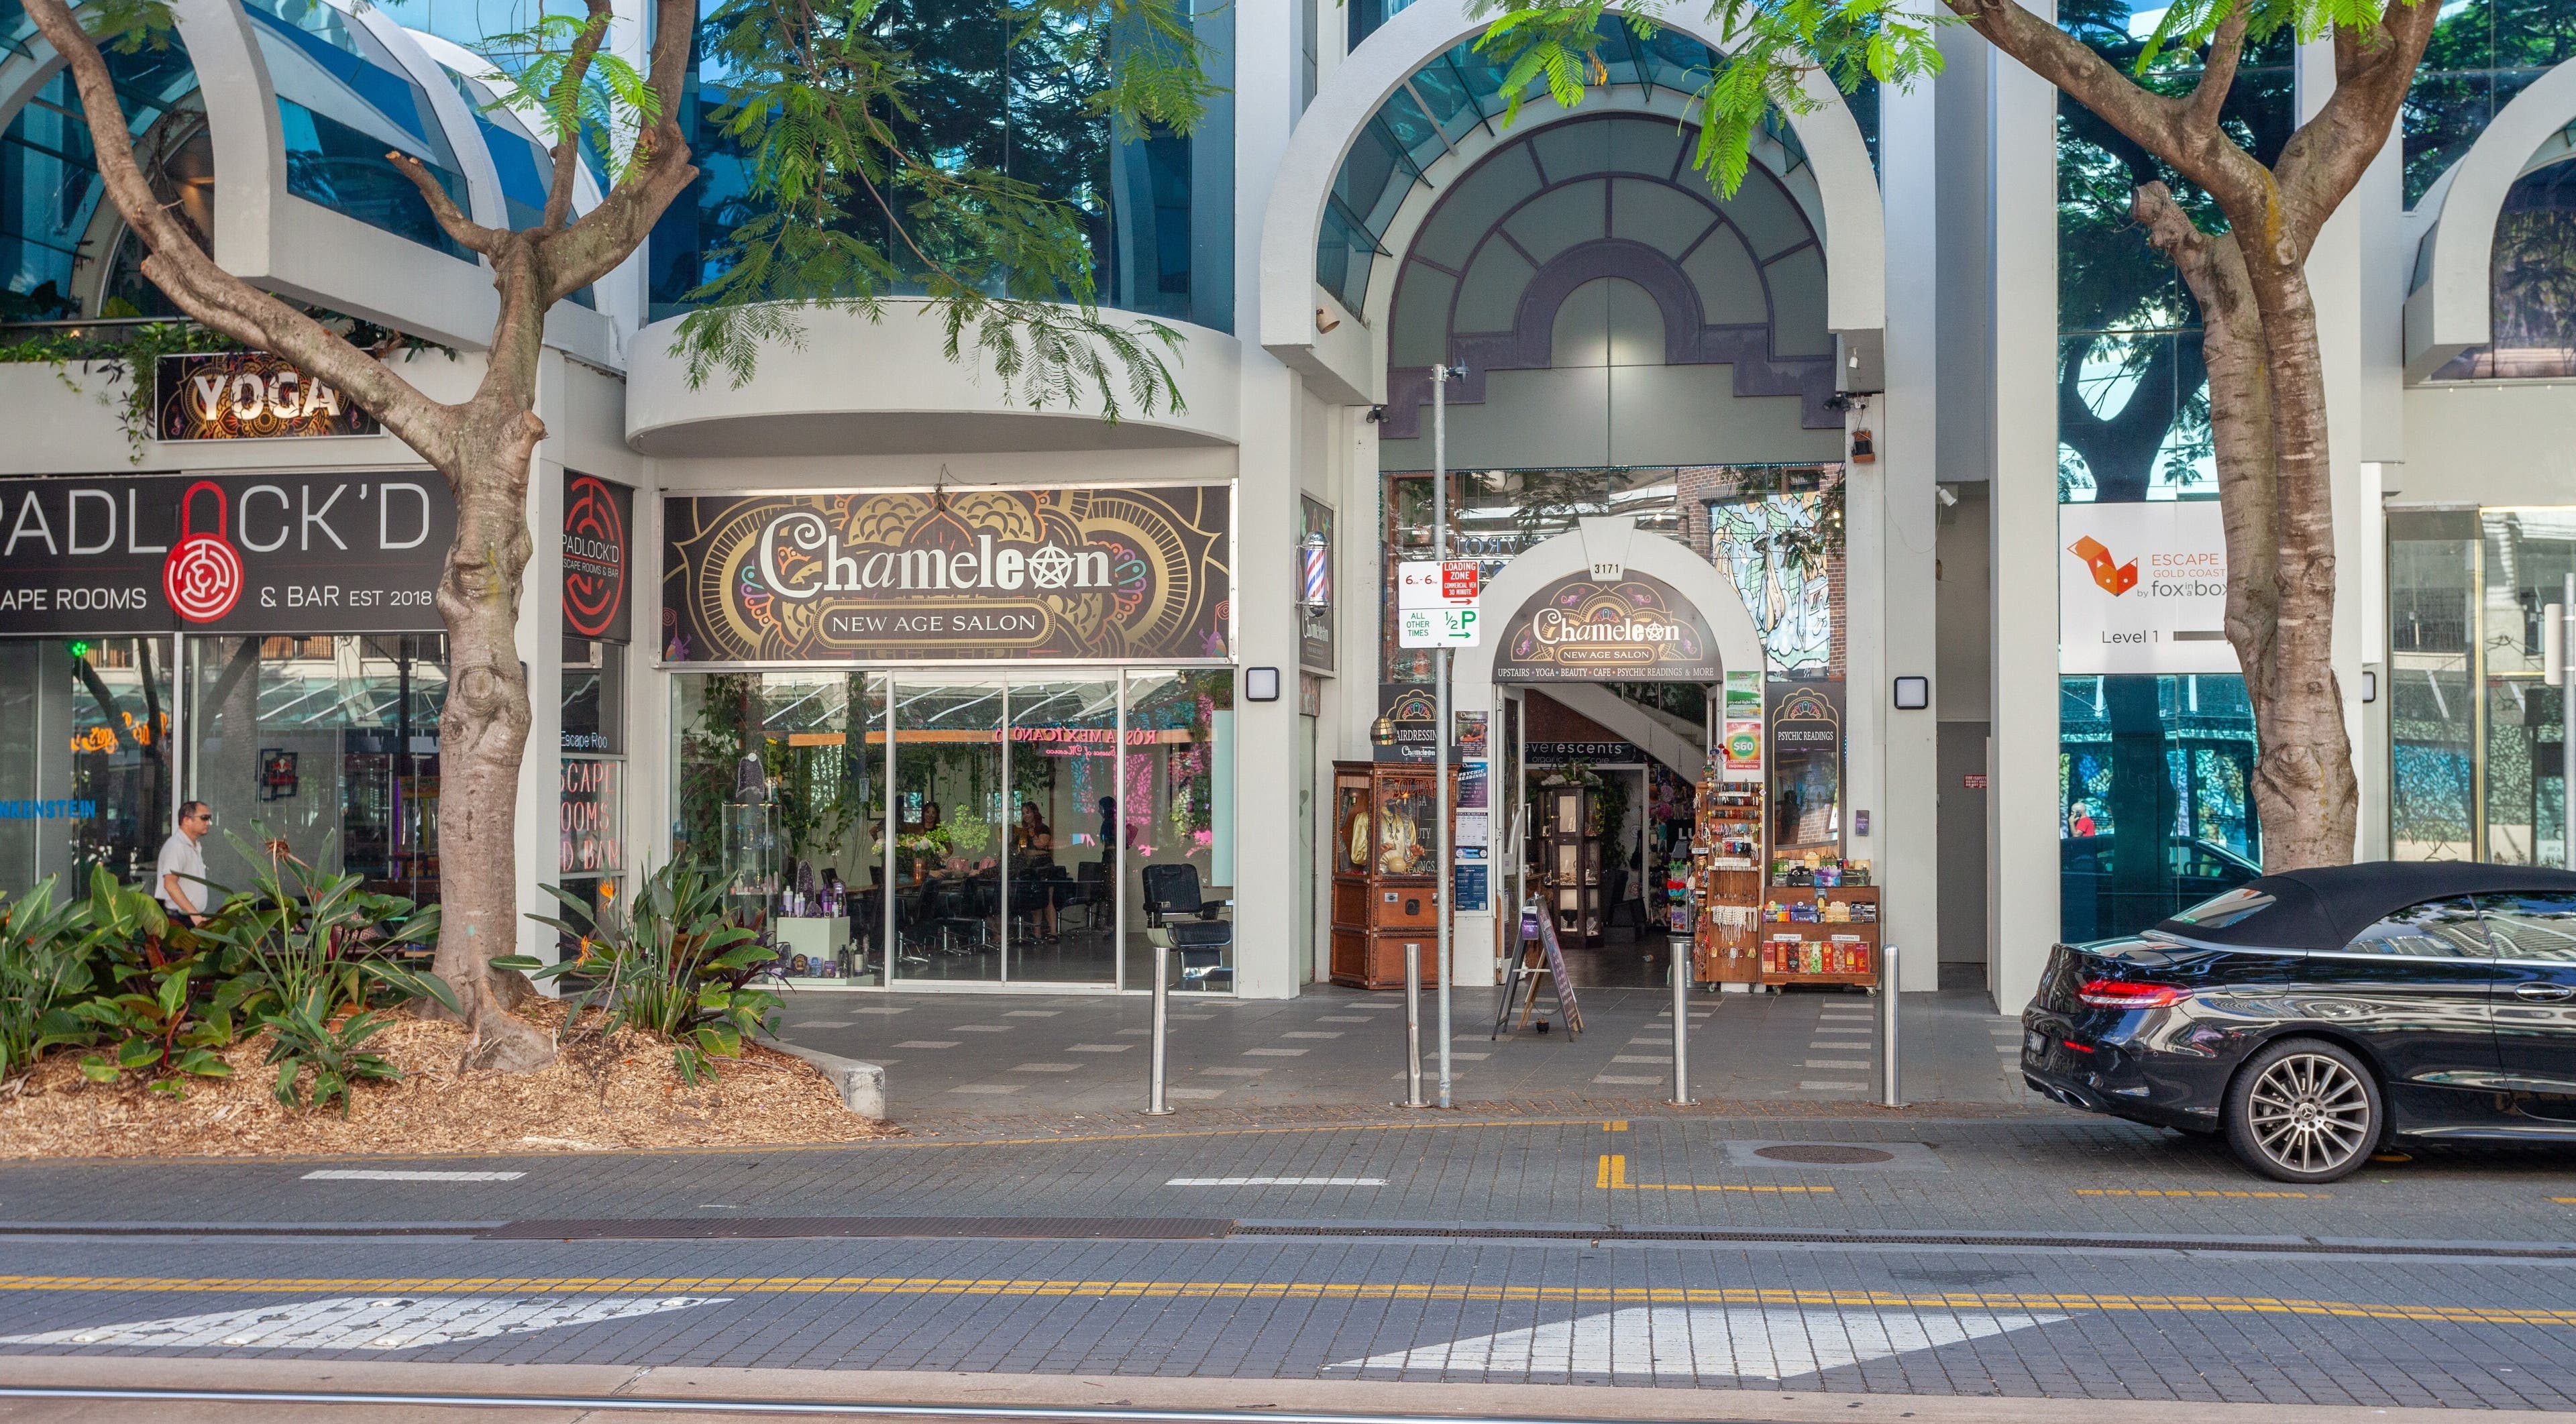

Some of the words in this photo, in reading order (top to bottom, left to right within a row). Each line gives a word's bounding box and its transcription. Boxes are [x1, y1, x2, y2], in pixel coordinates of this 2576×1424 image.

[194, 372, 340, 421] YOGA
[0, 481, 430, 557] ADLOCK'D
[760, 512, 1112, 598] Chameleon
[2151, 553, 2219, 566] ESCAPE
[564, 558, 581, 571] SCAPE
[582, 562, 602, 575] ROOMS
[608, 567, 619, 578] BAR
[1444, 562, 1476, 571] LOADING
[1594, 563, 1619, 574] 3171
[1450, 571, 1470, 580] ZONE
[2153, 569, 2185, 578] GOLD
[2188, 569, 2226, 578] COAST
[2137, 590, 2149, 598] by
[2151, 580, 2184, 597] fox
[0, 589, 48, 610] APE
[56, 588, 147, 610] ROOMS
[260, 586, 277, 608] &
[288, 585, 339, 607] BAR
[350, 590, 384, 606] EST
[390, 591, 433, 606] 2018
[1411, 612, 1426, 620] ALL
[1461, 610, 1477, 630] P
[833, 617, 888, 633] NEW
[894, 616, 943, 632] AGE
[952, 615, 1036, 631] SALON
[1406, 620, 1430, 628] OTHER
[1533, 608, 1680, 645] Chameleon
[1407, 629, 1430, 637] TIMES
[2102, 629, 2146, 643] Level
[2152, 629, 2158, 643] 1
[1563, 651, 1587, 659] NEW
[1589, 651, 1611, 659] AGE
[1497, 668, 1530, 677] UPSTAIRS
[1535, 668, 1555, 677] YOGA
[1560, 668, 1588, 677] BEAUTY
[1593, 668, 1611, 677] CAFE
[1617, 668, 1646, 677] PSYCHIC
[1647, 668, 1682, 677] READINGS
[1693, 667, 1714, 676] MORE
[1397, 730, 1437, 741] AIRDRESSIN
[1778, 731, 1803, 741] PSYCHIC
[1803, 731, 1834, 741] READINGS
[1733, 741, 1754, 751] $60
[1458, 769, 1485, 777] PSYCHIC
[0, 799, 96, 820] NKENSTEIN
[561, 801, 610, 832] OOMS
